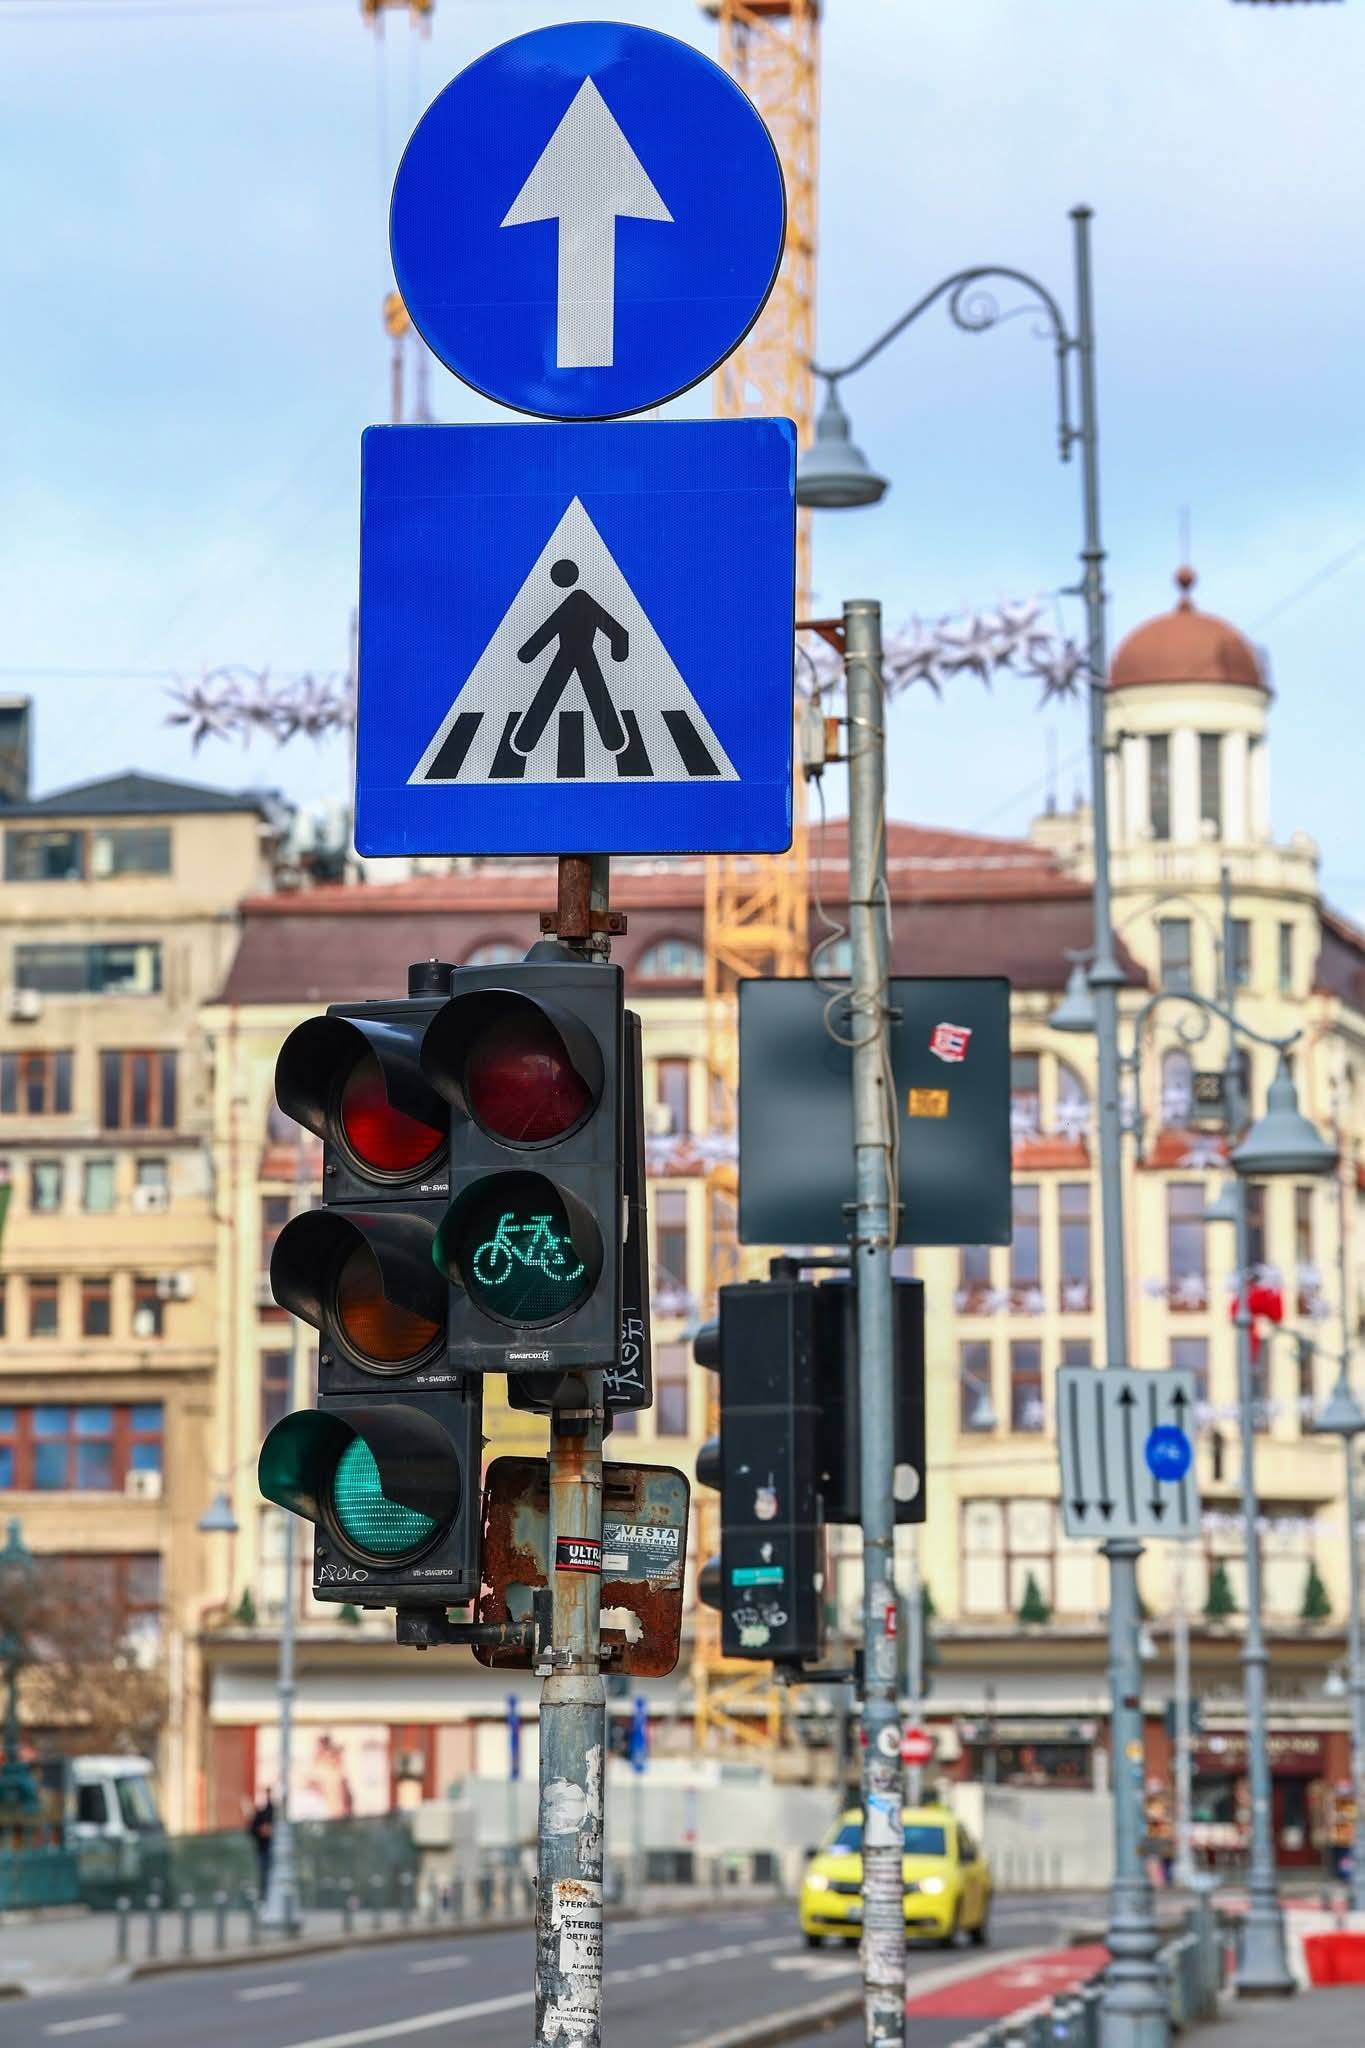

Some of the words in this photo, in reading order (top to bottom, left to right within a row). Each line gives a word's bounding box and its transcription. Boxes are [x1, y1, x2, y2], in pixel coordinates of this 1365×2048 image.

[623, 1526, 676, 1539] VESTA
[622, 1536, 677, 1546] INVESTMENT
[569, 1545, 601, 1560] ULTR
